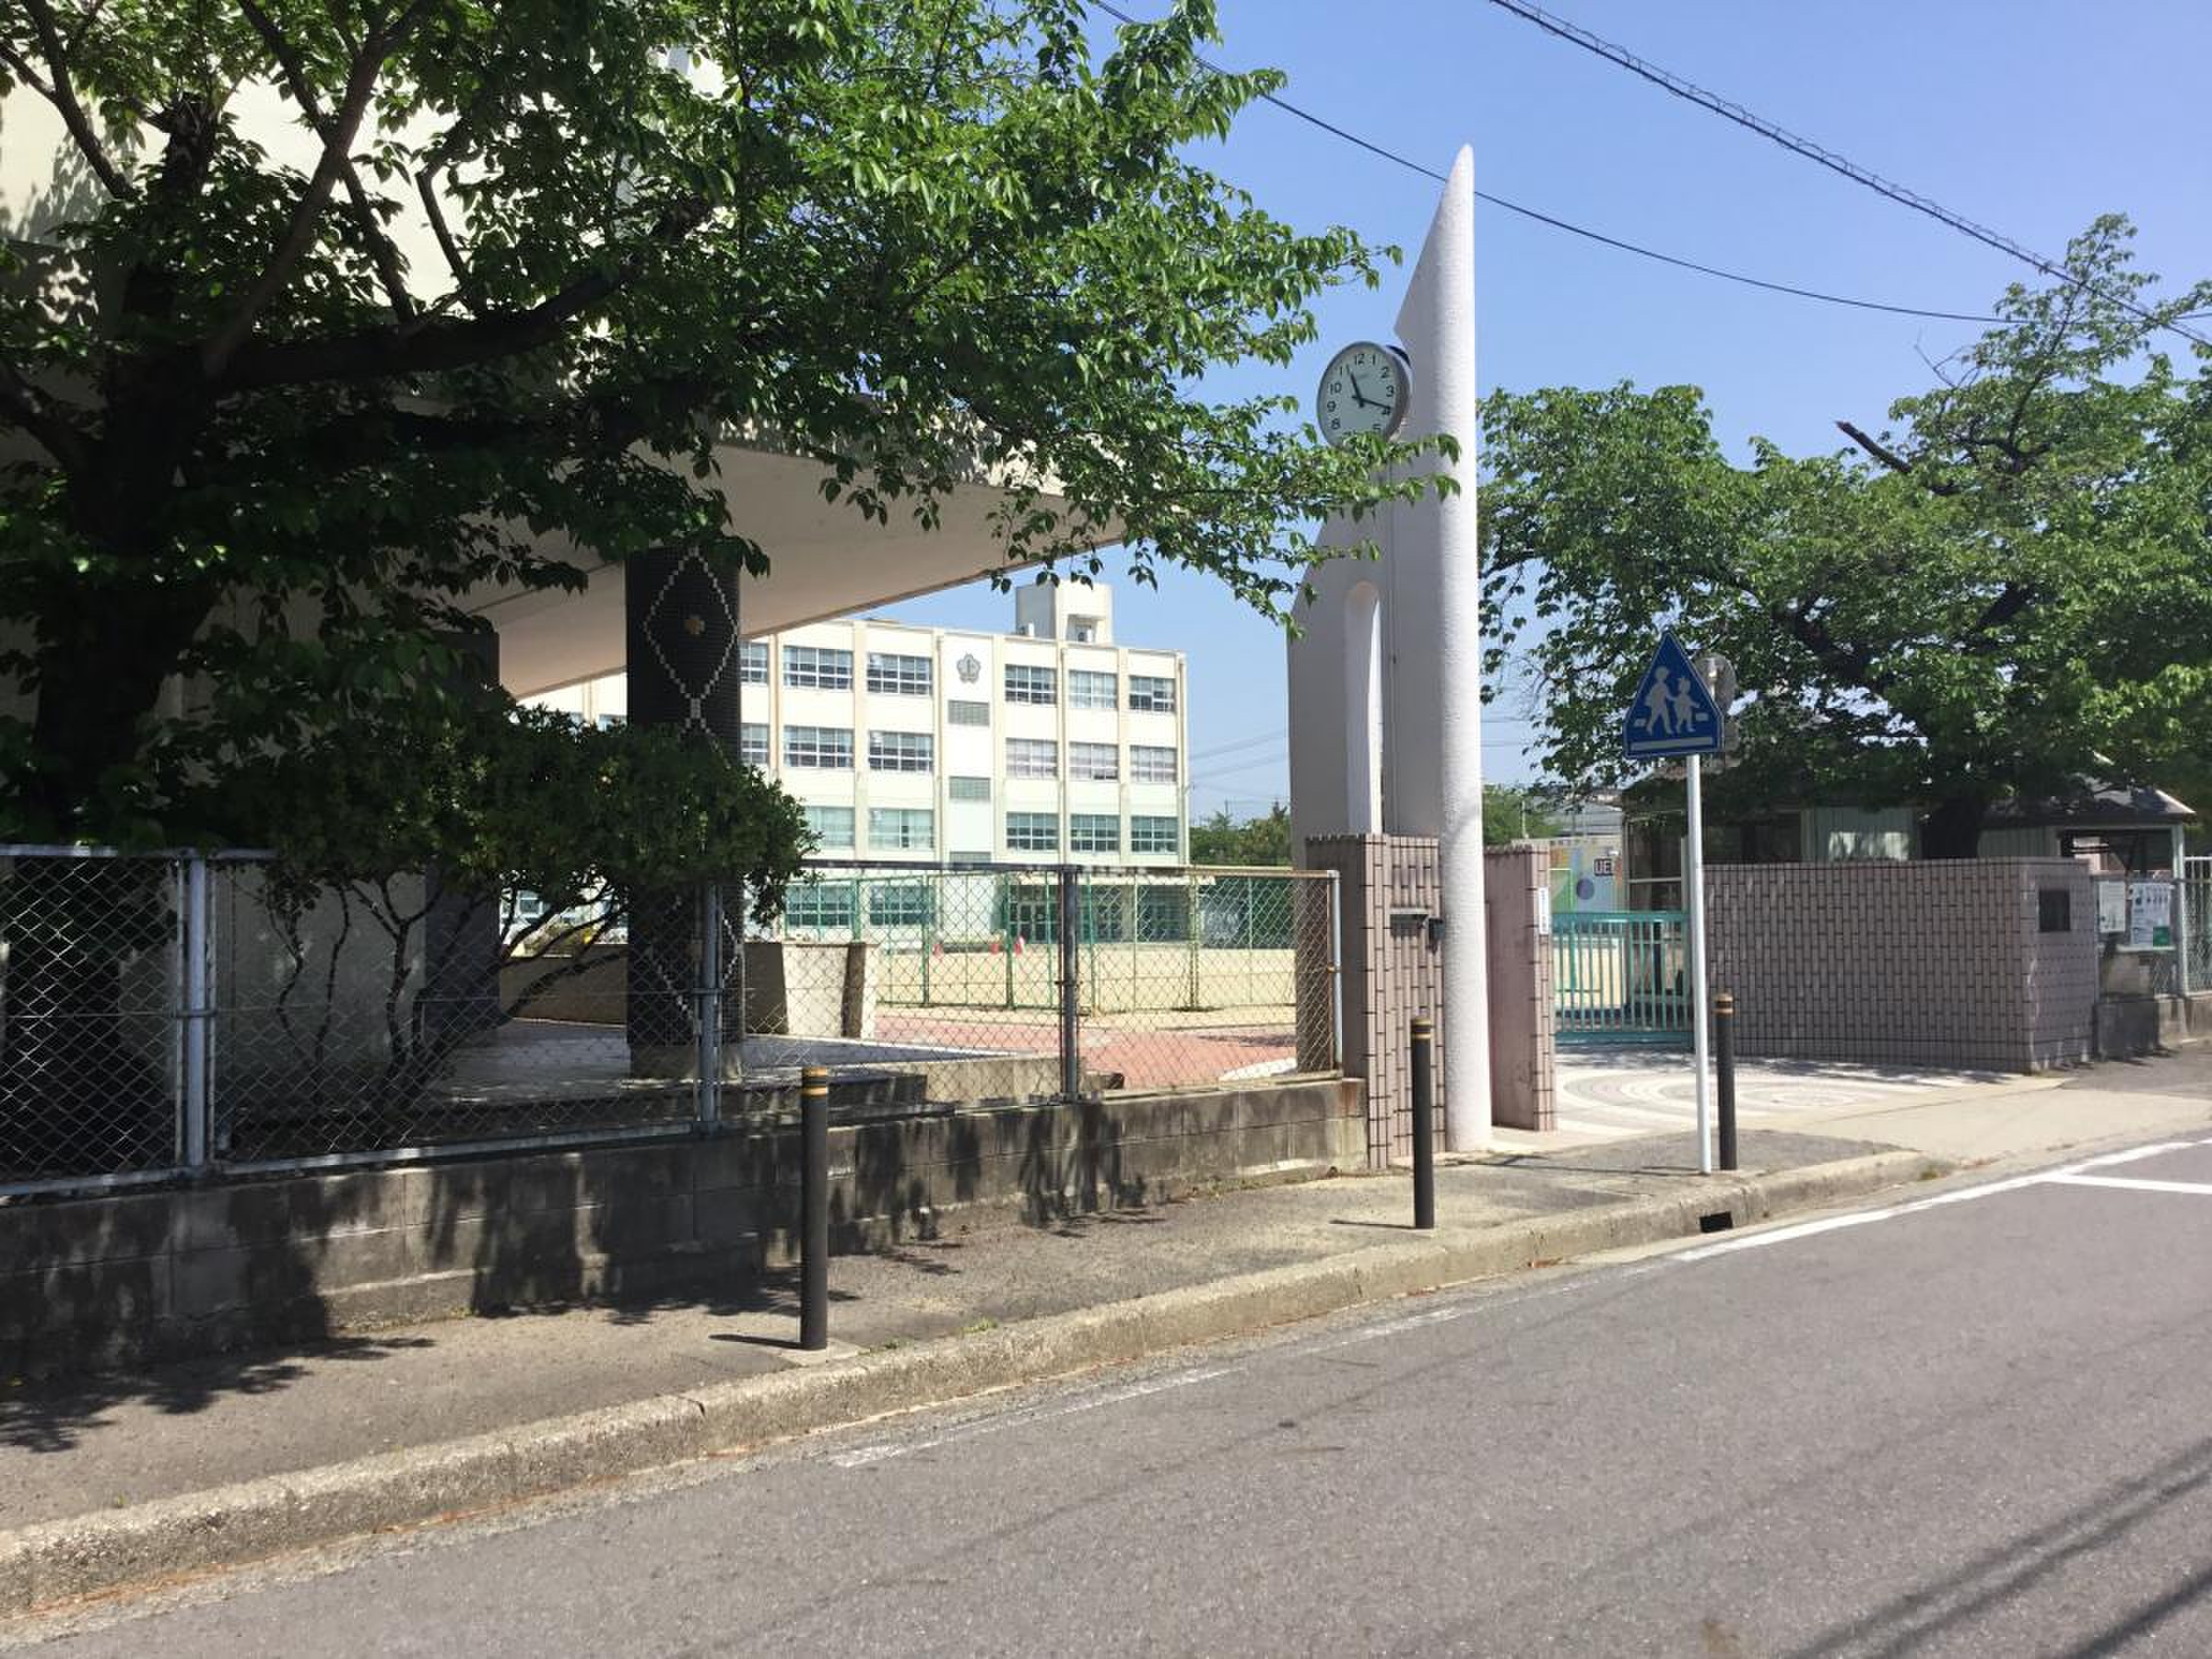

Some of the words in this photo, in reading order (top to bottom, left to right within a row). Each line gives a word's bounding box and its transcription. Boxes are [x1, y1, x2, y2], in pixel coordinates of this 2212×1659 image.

[1354, 353, 1365, 366] 12
[1381, 367, 1389, 379] 2
[1330, 382, 1342, 394] 10
[1385, 384, 1394, 397] 3
[1327, 400, 1336, 413] 9
[1331, 418, 1341, 429] 8
